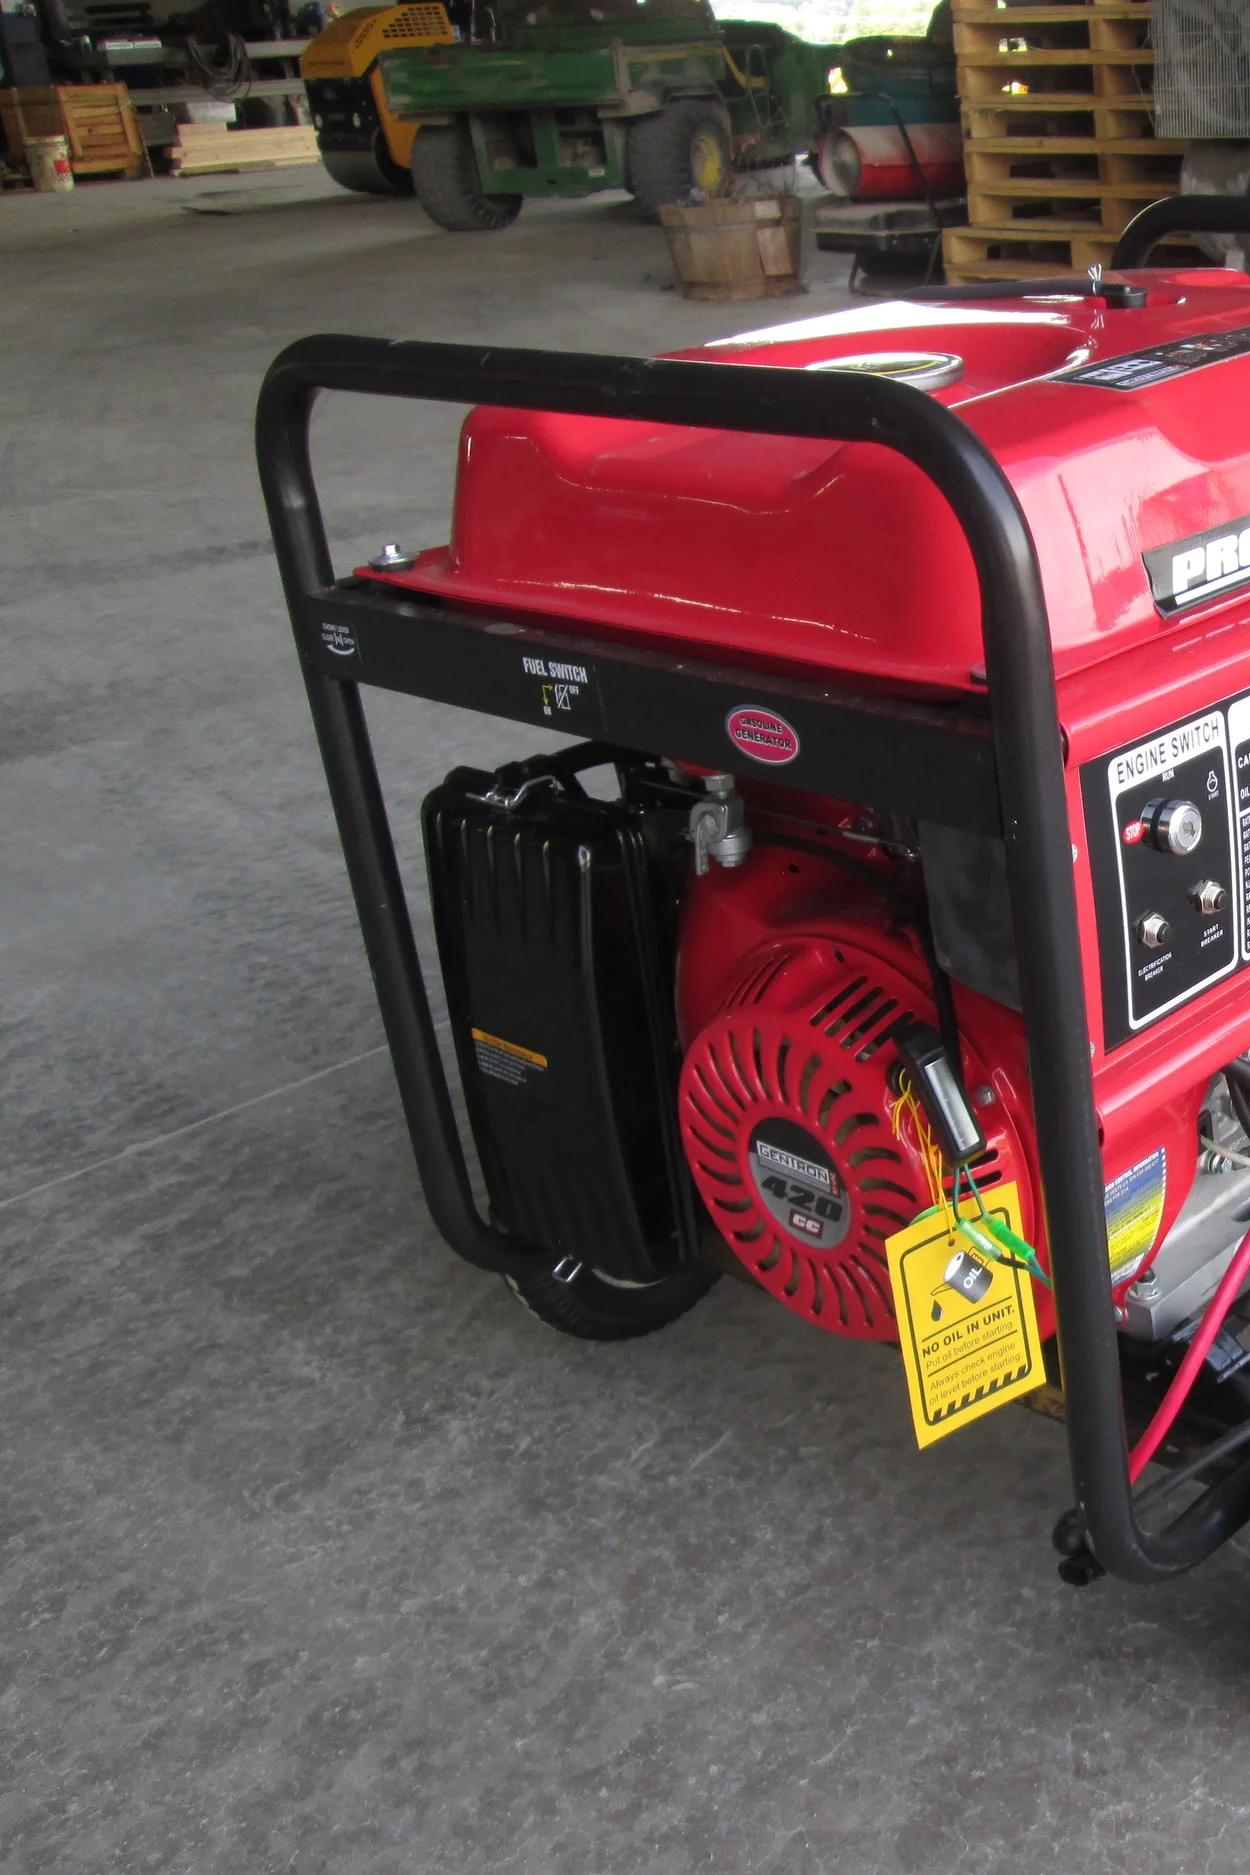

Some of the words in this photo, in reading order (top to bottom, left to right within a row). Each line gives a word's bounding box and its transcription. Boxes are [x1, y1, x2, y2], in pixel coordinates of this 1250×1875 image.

[522, 656, 548, 676] FUEL
[548, 661, 588, 683] SWITCH
[739, 716, 783, 735] GASOLINE
[735, 728, 792, 751] GENERATOR
[1116, 742, 1167, 784] ENGINE
[1171, 717, 1220, 758] SWITCH
[1161, 768, 1175, 782] RUN
[1240, 786, 1250, 800] OIL
[1125, 821, 1141, 841] STOP
[1200, 929, 1224, 948] BREAKER
[1203, 923, 1219, 938] START
[1138, 951, 1173, 977] ELECTRIFICATION
[1144, 965, 1164, 981] BREAKER
[759, 1143, 828, 1183] GENTRON
[761, 1175, 843, 1223] 420
[792, 1213, 820, 1234] CC
[963, 1266, 983, 1289] OIL
[922, 1341, 940, 1359] NO
[943, 1329, 964, 1347] OIL
[966, 1320, 980, 1335] IN
[983, 1304, 1015, 1326] UNIT.
[925, 1358, 941, 1370] Put
[942, 1350, 952, 1363] oil
[953, 1337, 980, 1356] before
[929, 1370, 960, 1392] Always
[961, 1355, 986, 1375] check
[987, 1342, 1016, 1361] engine
[928, 1393, 939, 1406] oil
[940, 1383, 962, 1400] level
[961, 1368, 989, 1387] before
